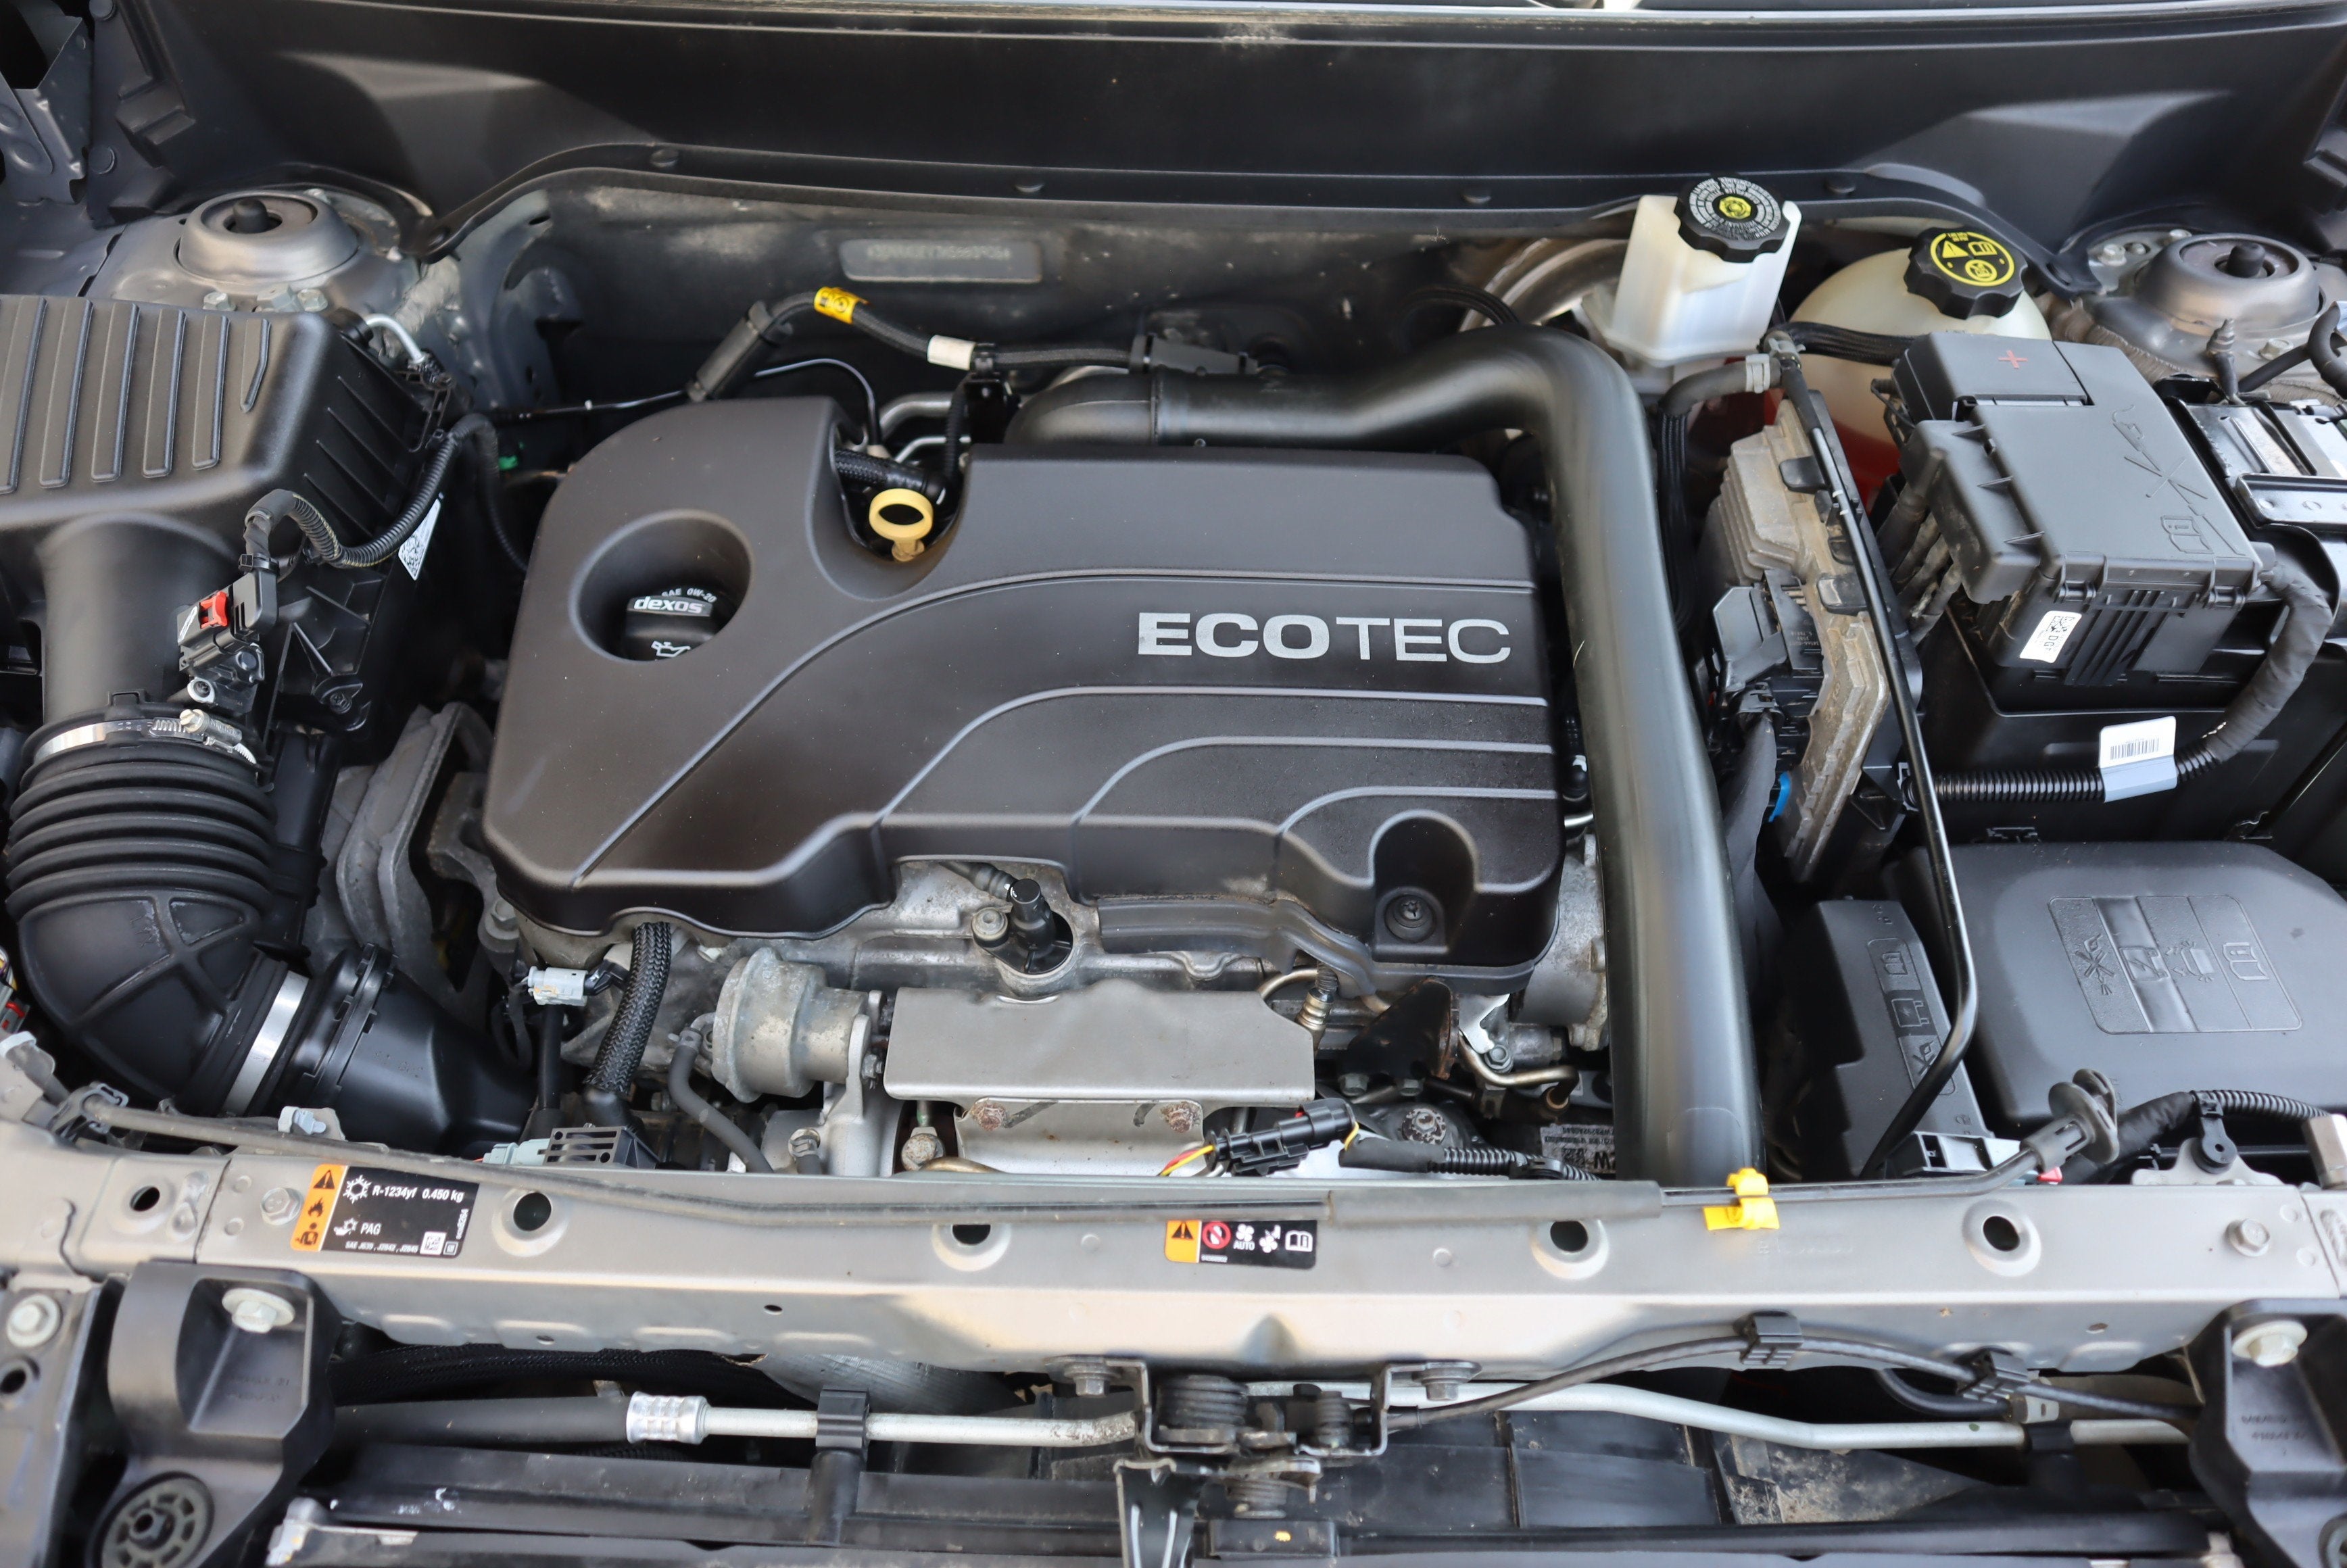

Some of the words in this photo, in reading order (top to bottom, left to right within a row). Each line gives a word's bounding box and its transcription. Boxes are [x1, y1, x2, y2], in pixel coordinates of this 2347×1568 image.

[661, 588, 682, 597] SAE
[686, 587, 718, 603] 0W-20
[633, 595, 703, 614] dexos
[1138, 612, 1511, 664] ECOTEC
[372, 1185, 418, 1200] R-1234yf
[422, 1187, 450, 1200] 0.450
[450, 1189, 465, 1203] kg
[360, 1222, 382, 1235] PAG
[1233, 1240, 1255, 1251] AUTO
